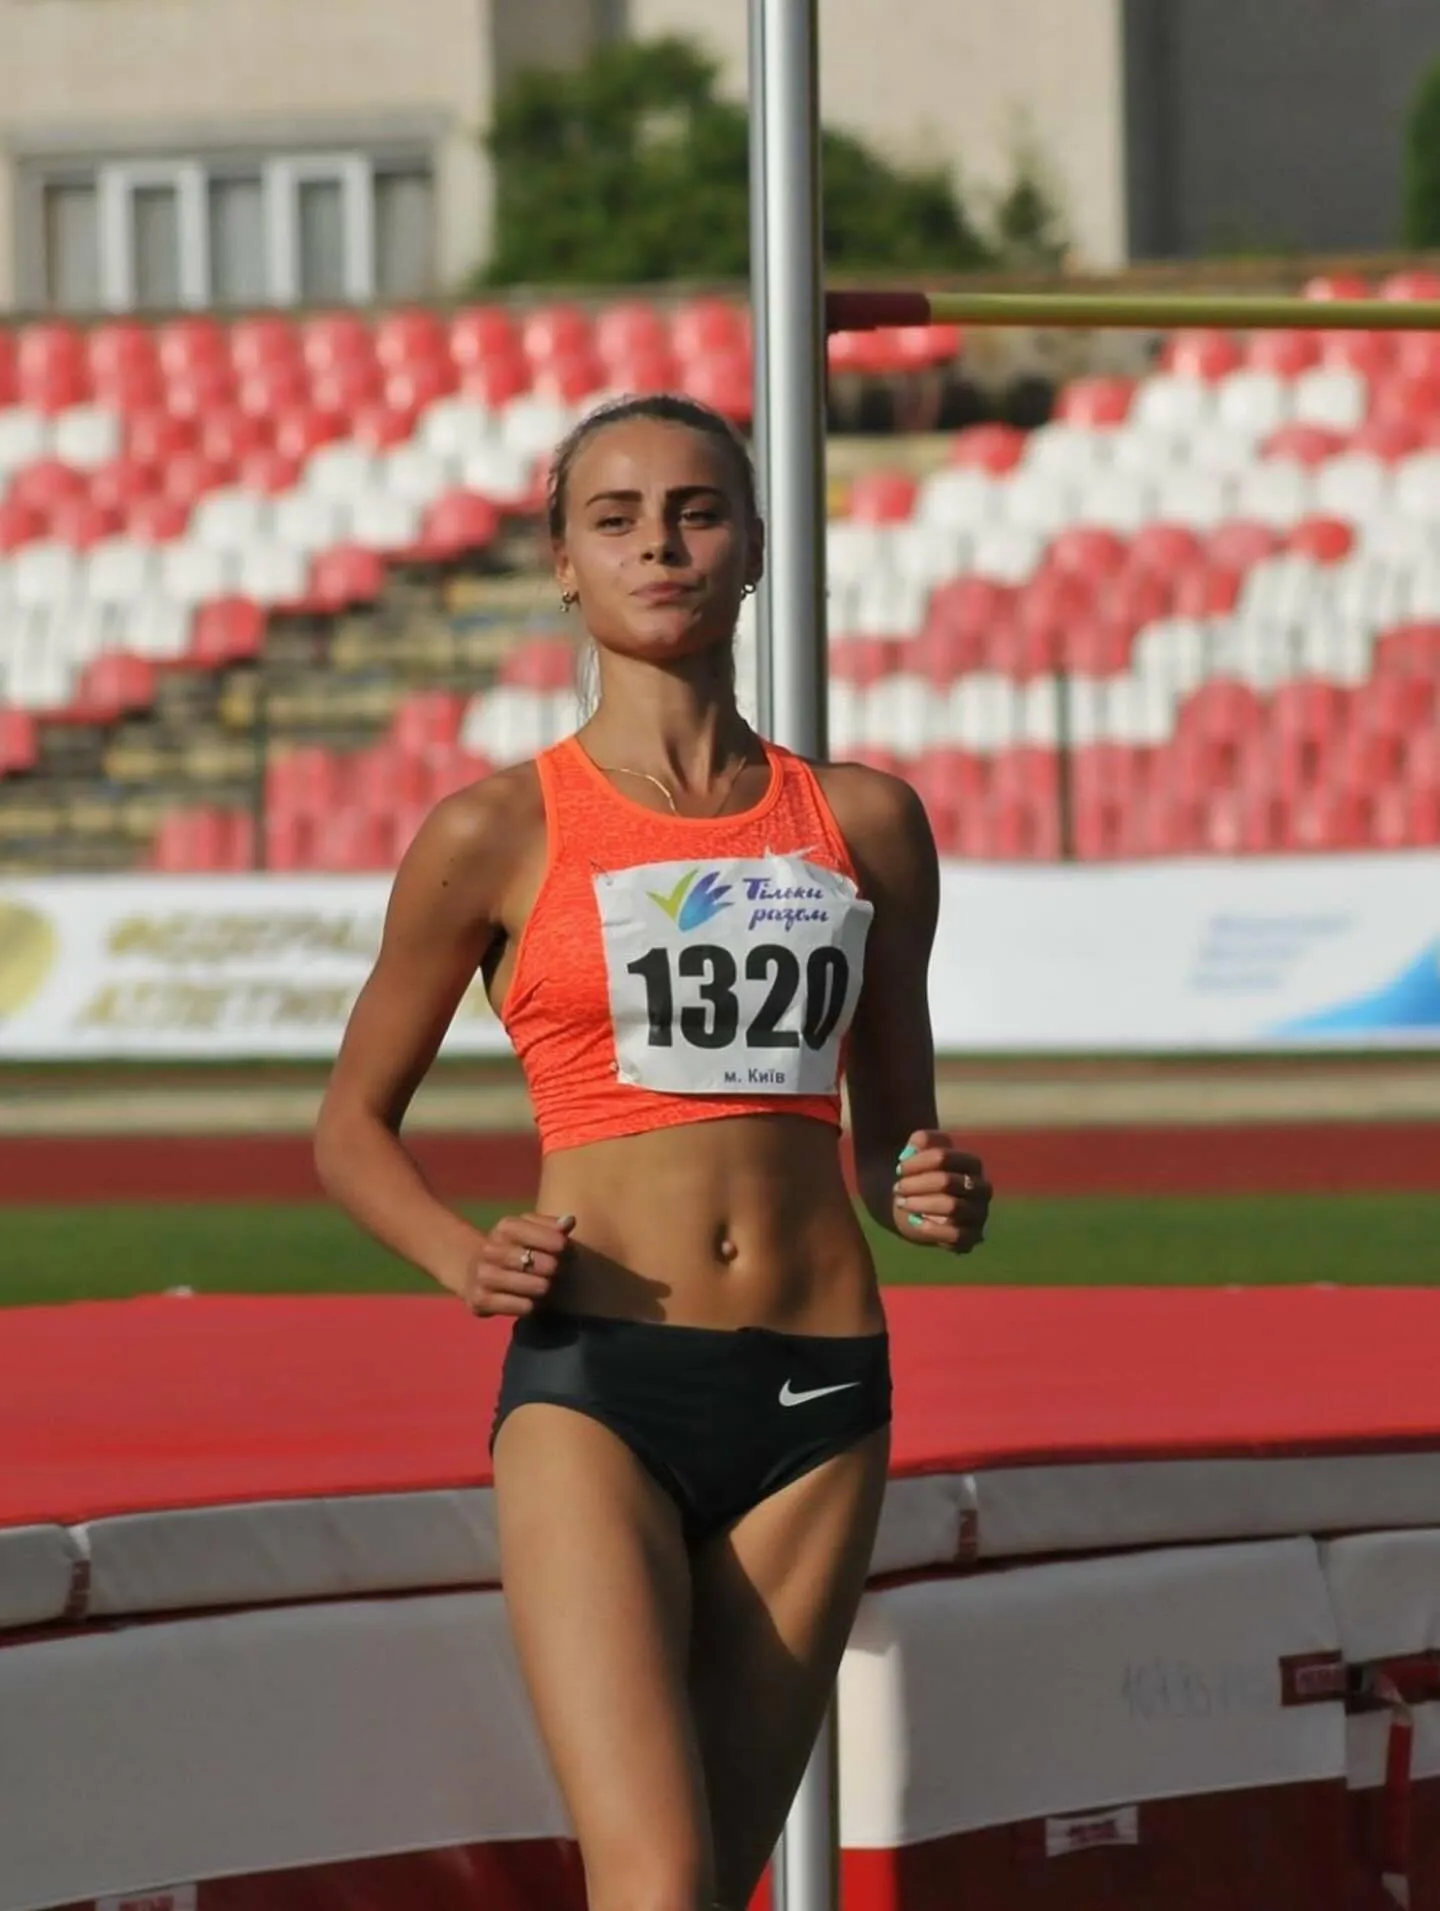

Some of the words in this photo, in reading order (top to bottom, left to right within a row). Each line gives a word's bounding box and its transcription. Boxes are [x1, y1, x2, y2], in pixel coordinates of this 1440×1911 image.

[742, 877, 824, 900] Тільки
[748, 908, 830, 932] разом
[627, 943, 849, 1051] 1320
[724, 1071, 742, 1084] м.
[748, 1068, 786, 1084] Київ
